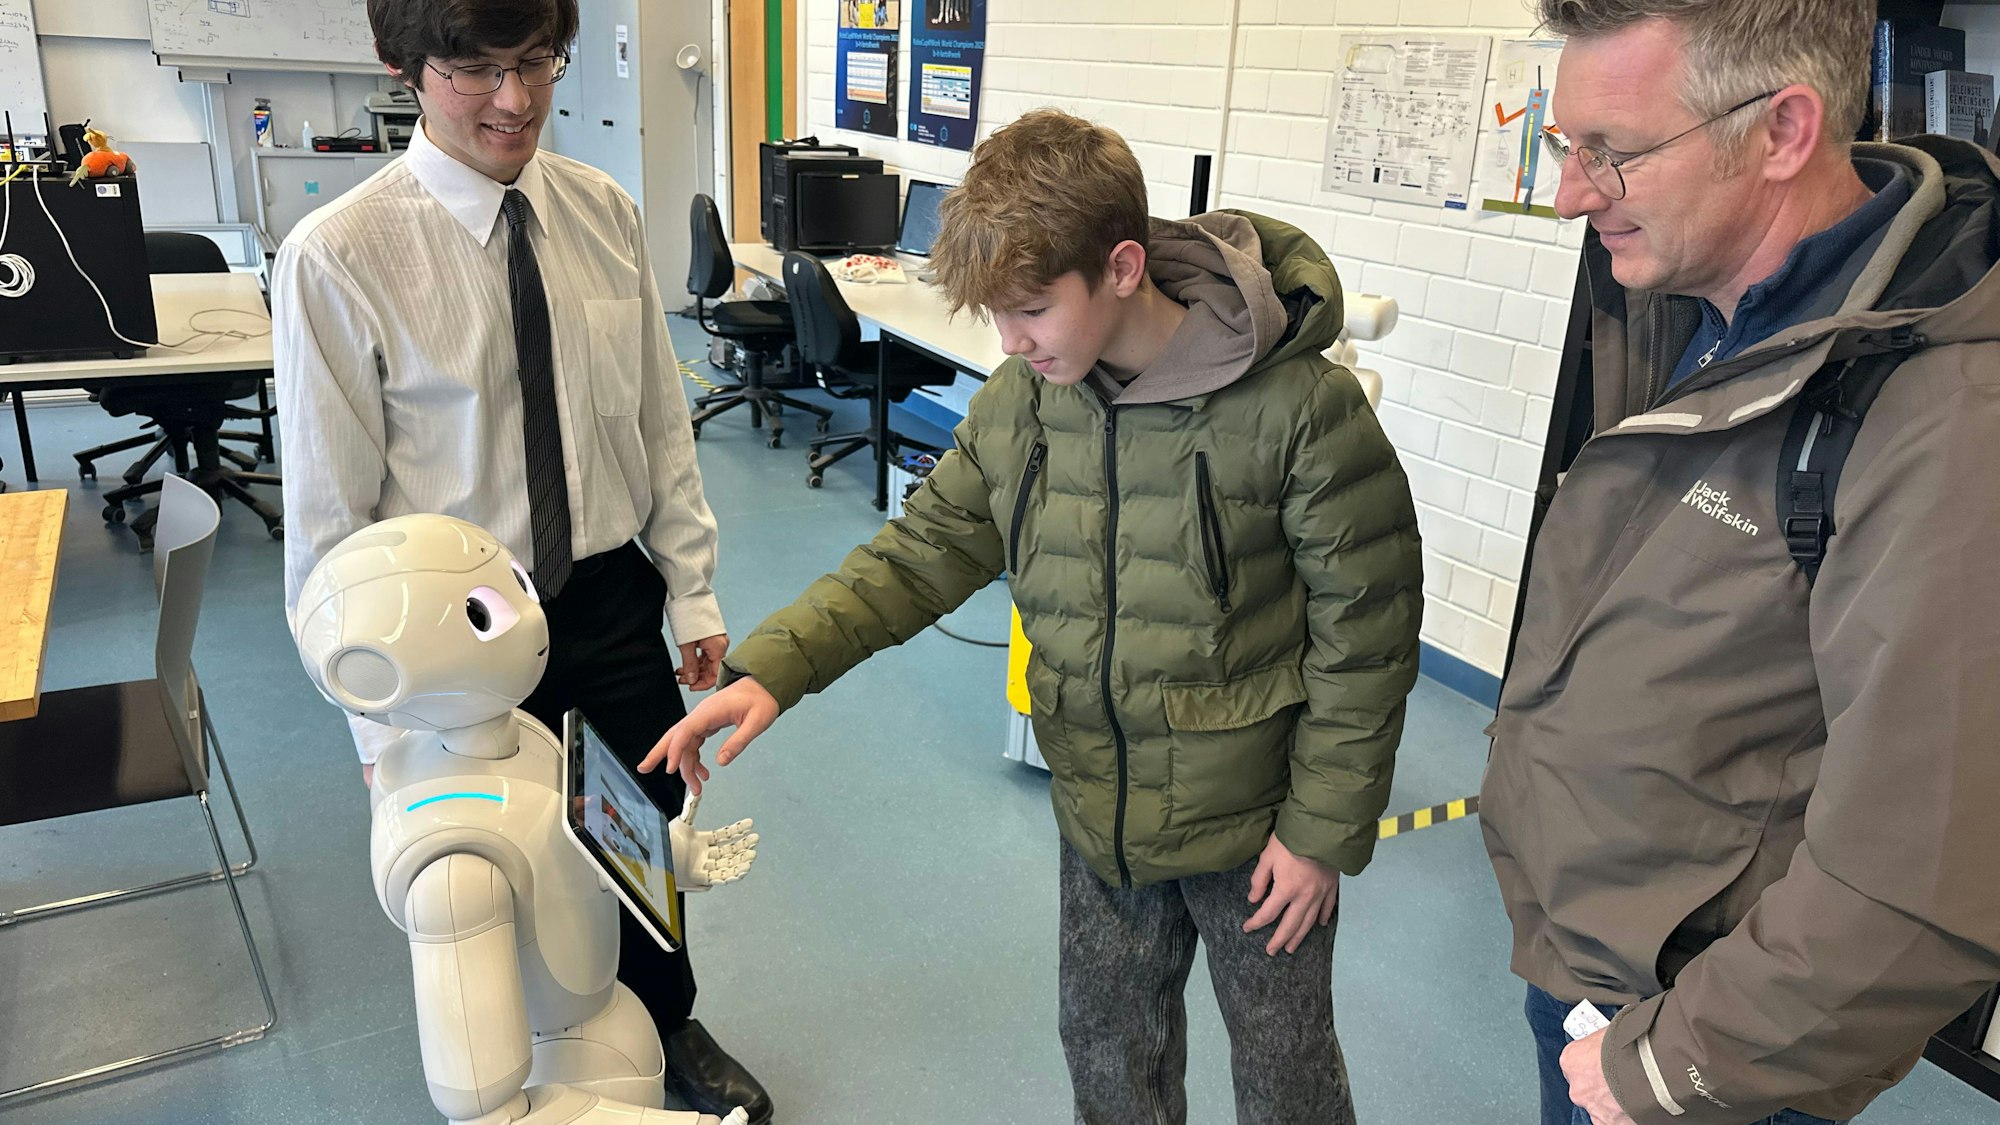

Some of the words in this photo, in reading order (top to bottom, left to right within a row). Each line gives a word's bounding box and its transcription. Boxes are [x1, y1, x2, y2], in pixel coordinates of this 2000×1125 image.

[1950, 95, 1990, 108] GEMEINSAME
[1950, 105, 1991, 118] WIRKLICHKEIT
[1696, 482, 1731, 507] Jack
[1690, 493, 1759, 536] Wolfskin
